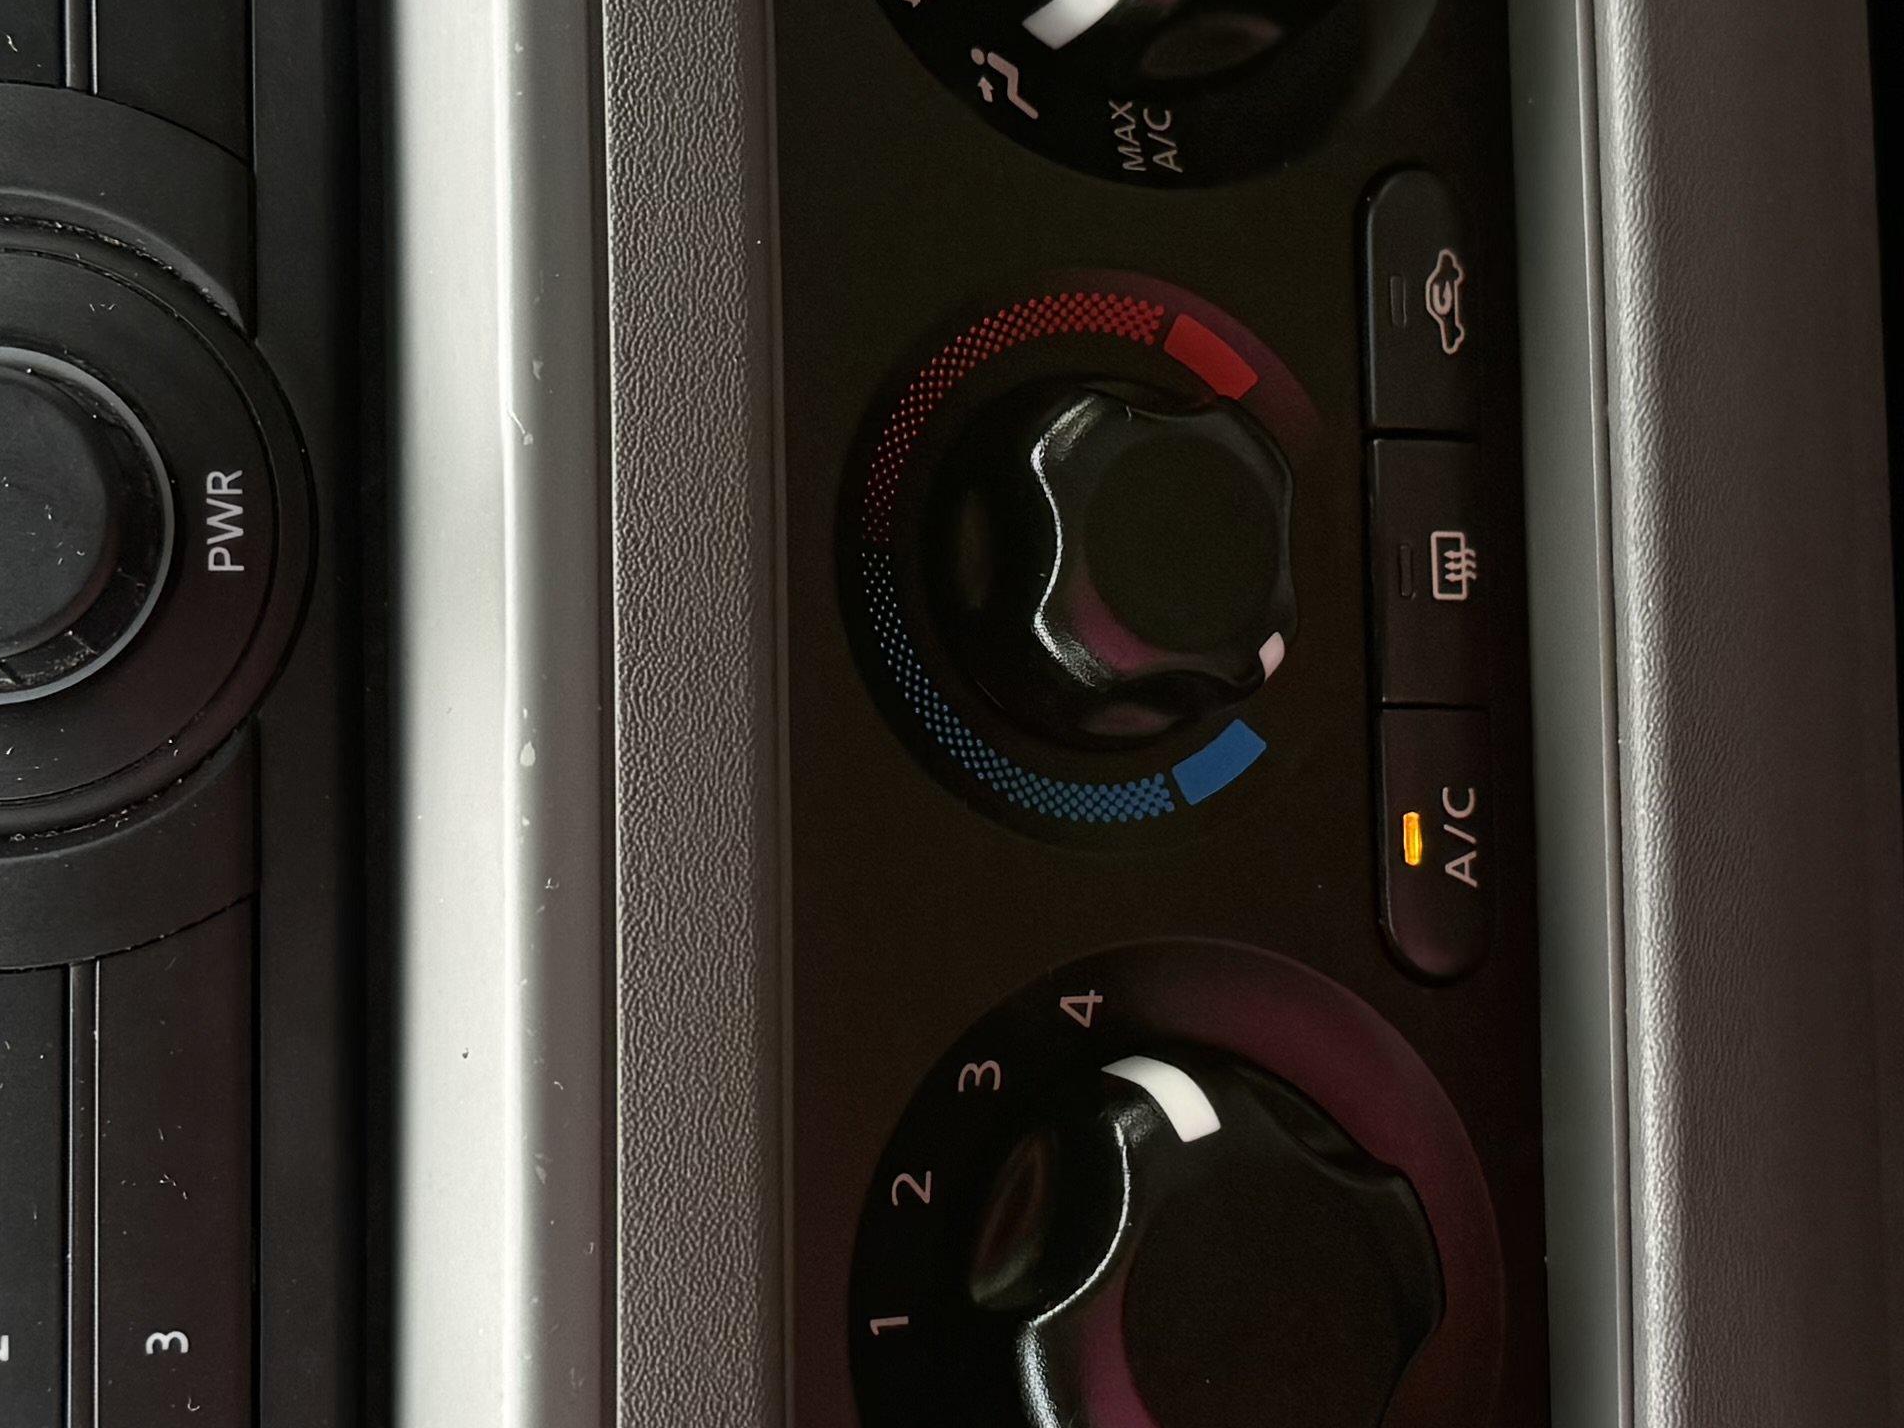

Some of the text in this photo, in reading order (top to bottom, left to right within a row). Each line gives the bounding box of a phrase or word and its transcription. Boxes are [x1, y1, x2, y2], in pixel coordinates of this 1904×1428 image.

[1109, 101, 1146, 172] MAX
[1142, 106, 1183, 172] A/C
[207, 471, 244, 571] PWR
[1443, 787, 1477, 887] A/C
[1060, 990, 1103, 1027] 4
[958, 1060, 1000, 1092] 3
[892, 1171, 931, 1205] 2
[146, 1331, 188, 1354] 3
[870, 1316, 908, 1335] 1
